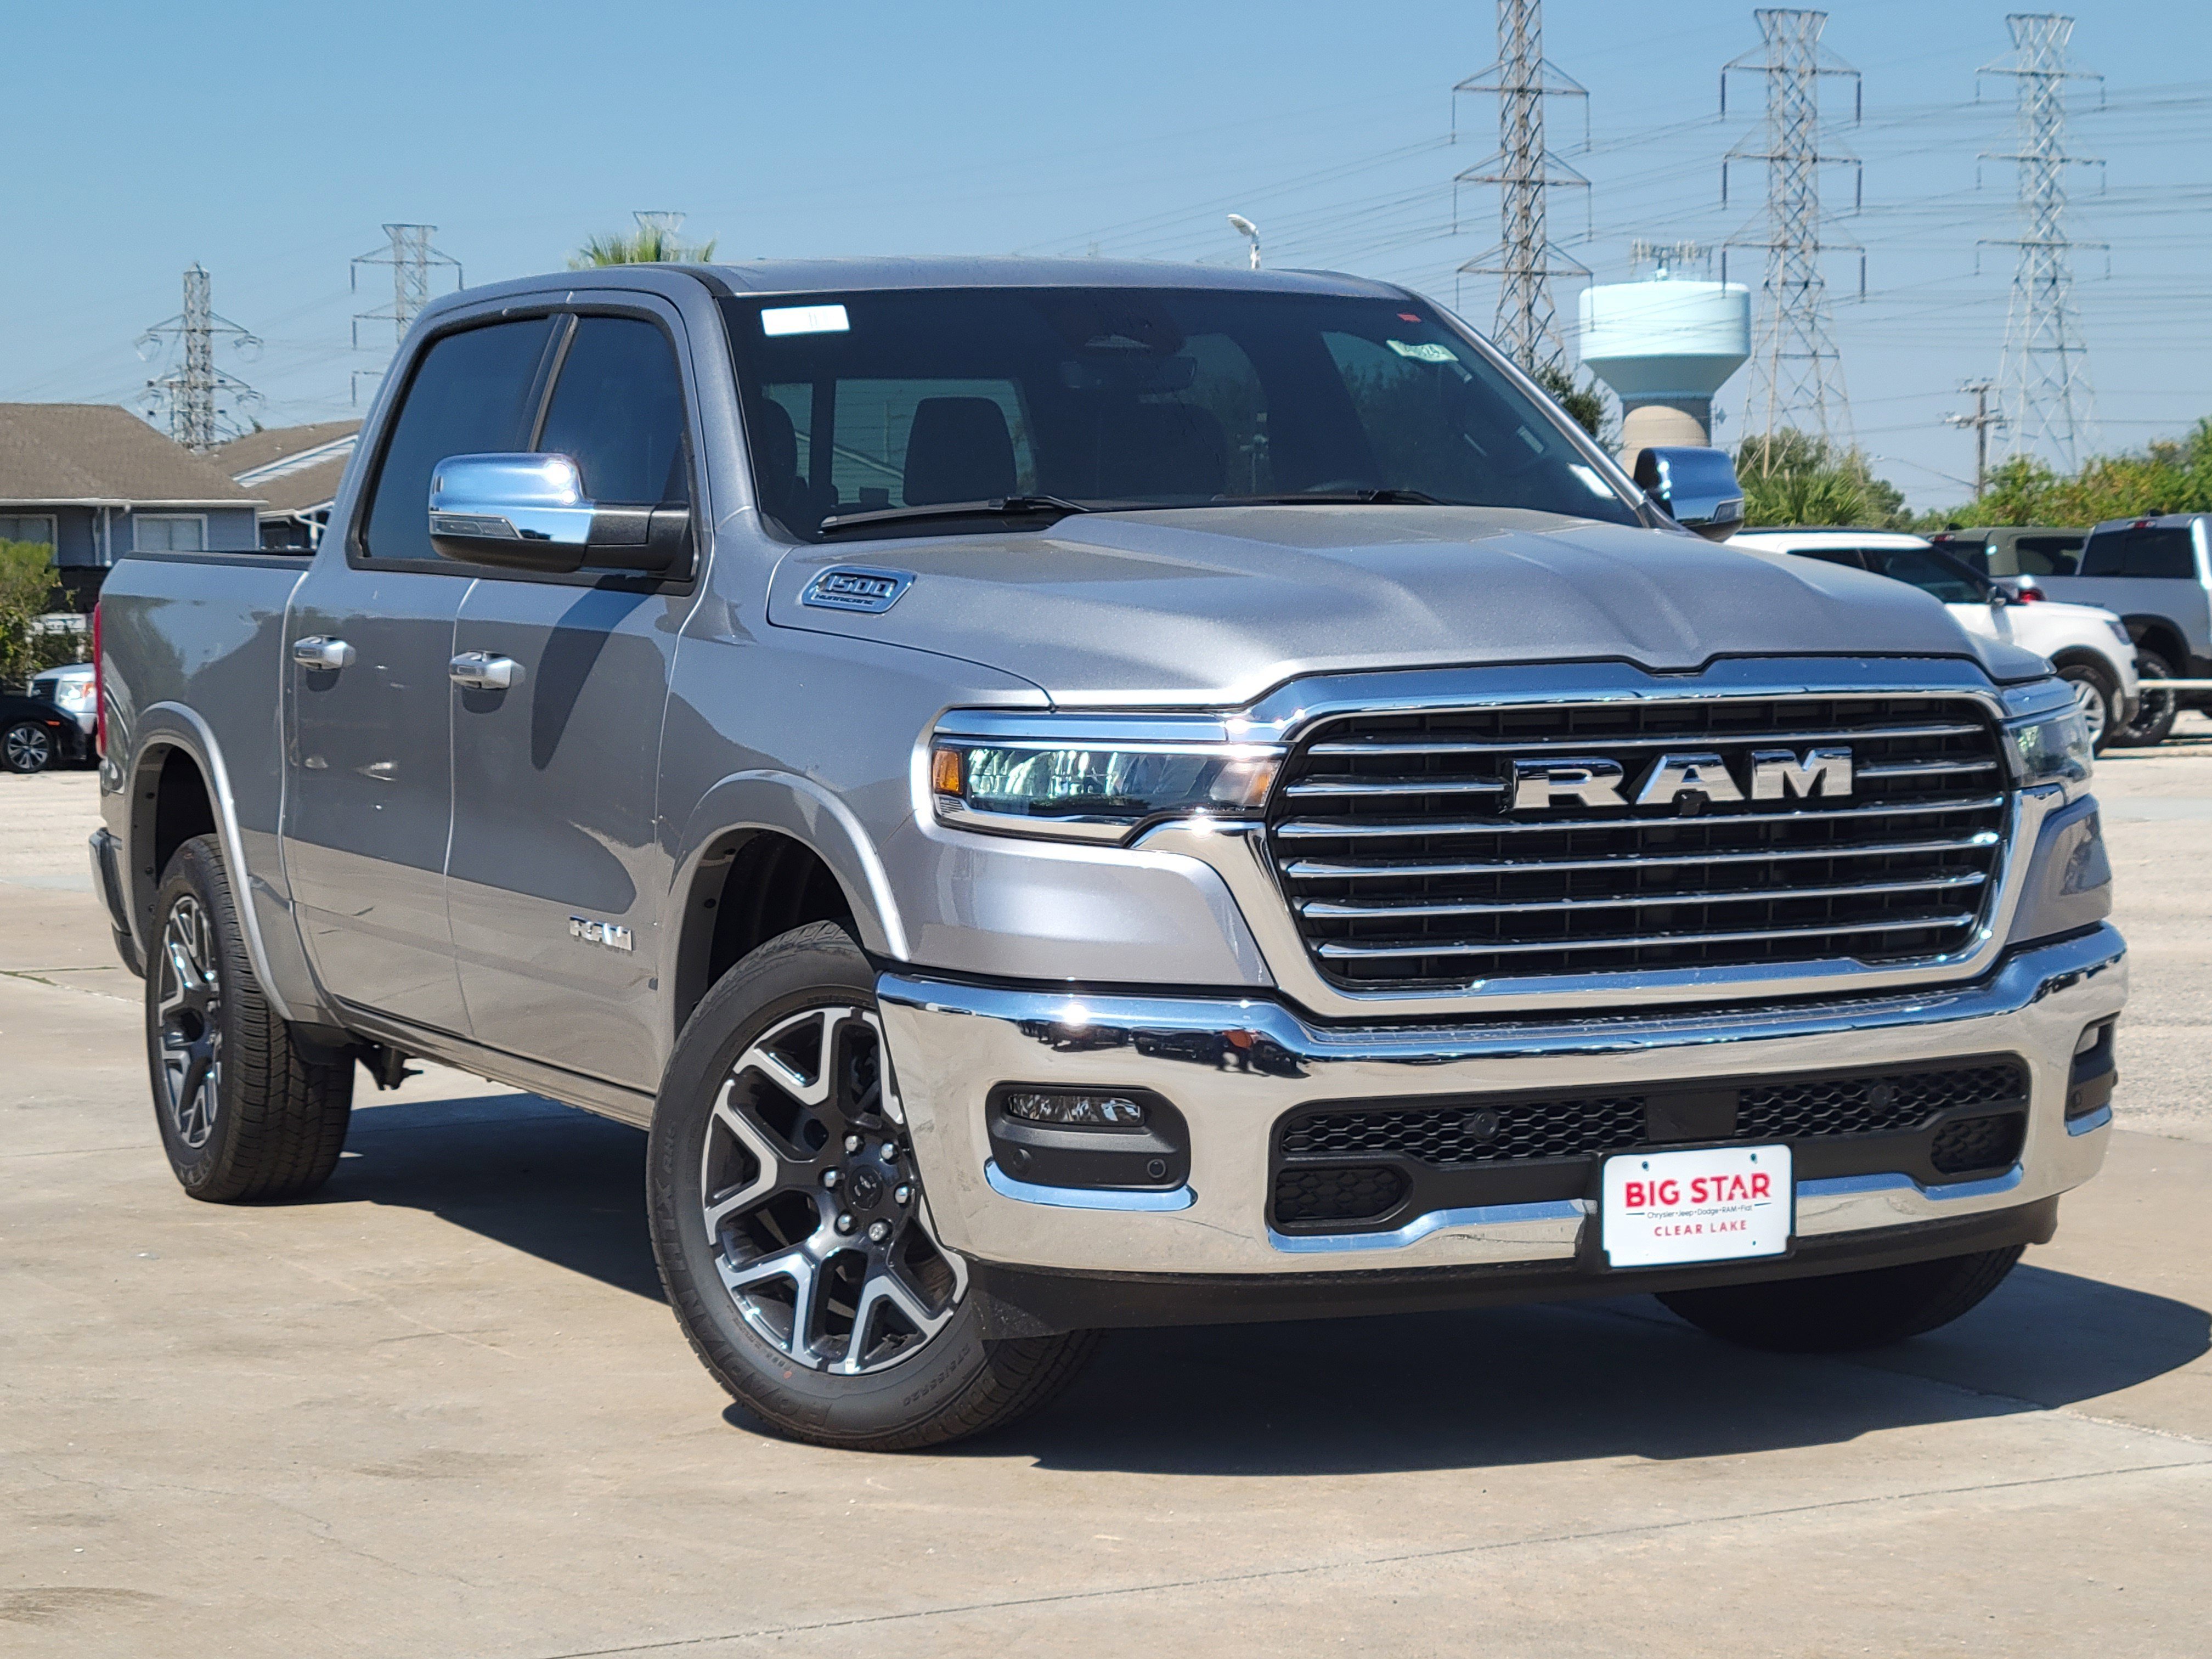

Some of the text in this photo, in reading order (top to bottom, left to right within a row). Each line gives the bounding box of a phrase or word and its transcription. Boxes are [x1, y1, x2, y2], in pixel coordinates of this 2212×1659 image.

[826, 575, 895, 598] 1500
[1513, 746, 1853, 809] RAM
[569, 915, 634, 951] RAM
[1624, 1172, 1770, 1208] BIG STAR
[654, 1177, 686, 1272] HTX
[1654, 1220, 1747, 1237] CLEAR LAKE
